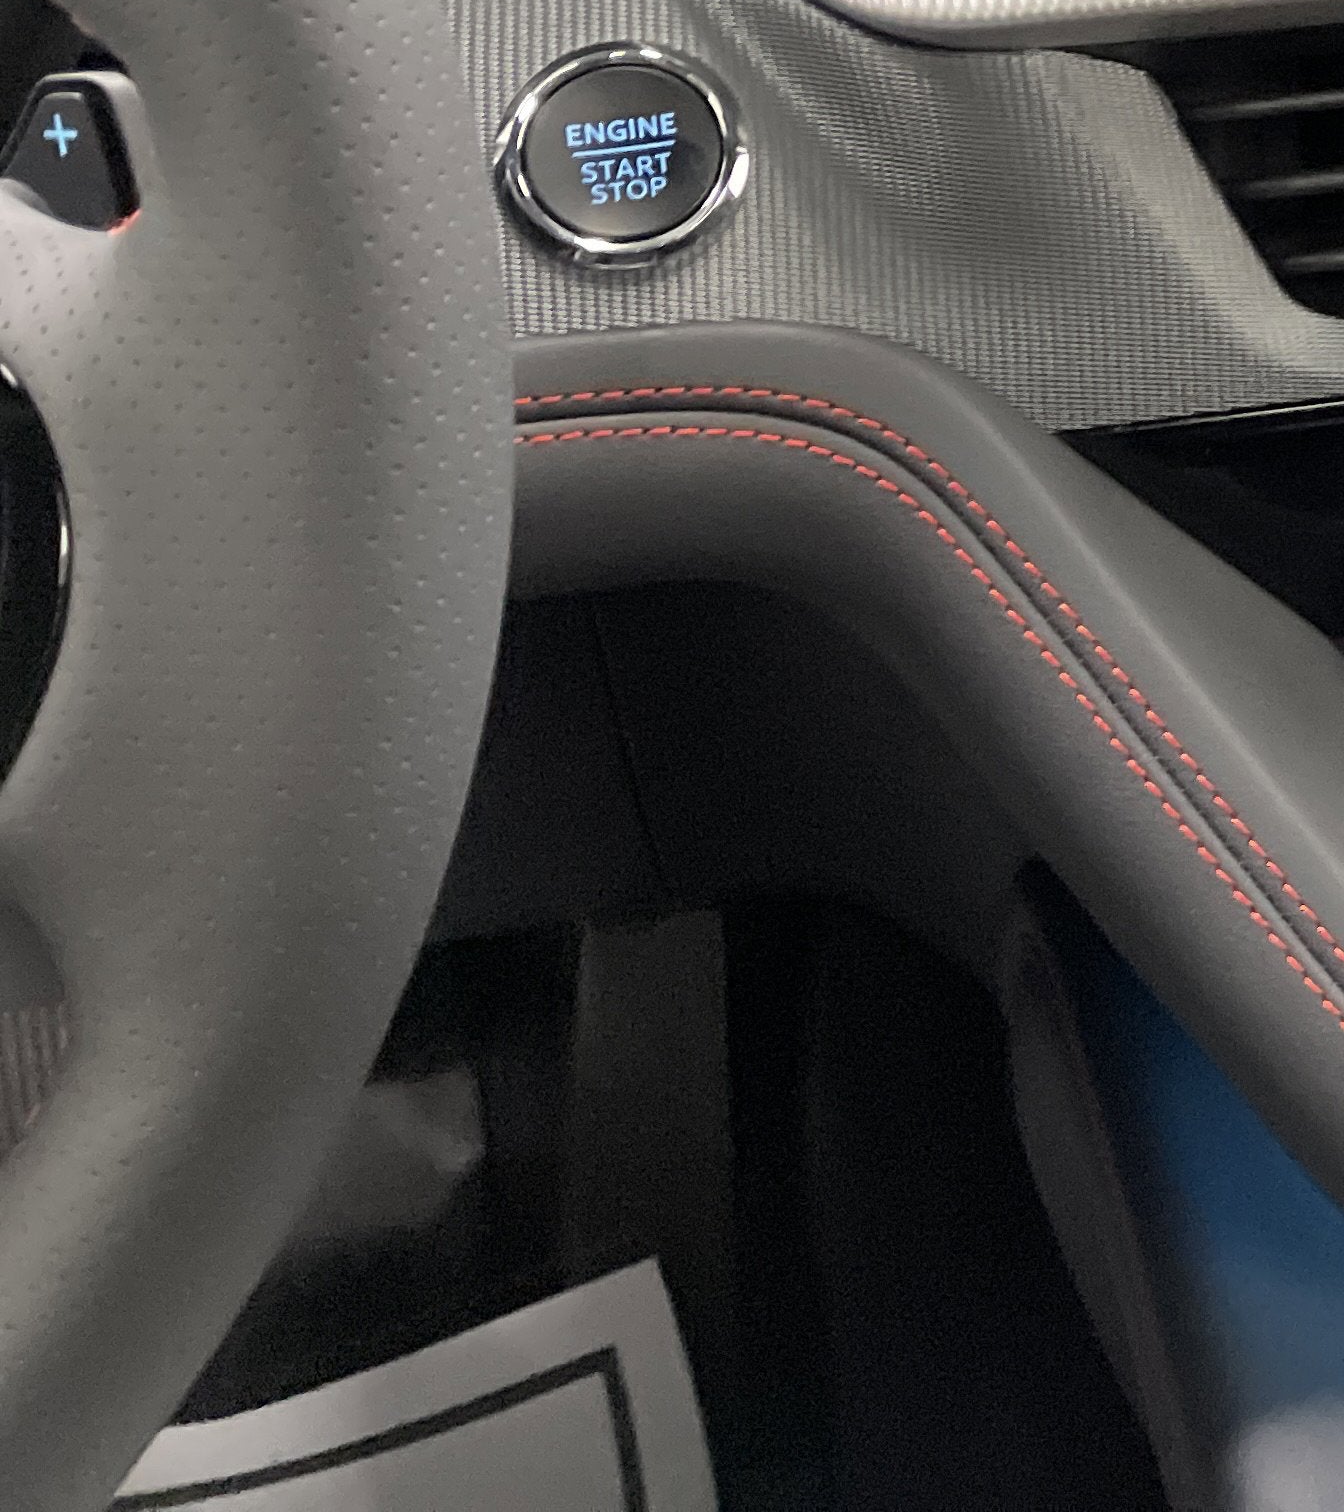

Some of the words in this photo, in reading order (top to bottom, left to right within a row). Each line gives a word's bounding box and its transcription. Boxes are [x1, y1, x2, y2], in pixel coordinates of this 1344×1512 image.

[564, 111, 678, 148] ENGINE
[580, 150, 672, 185] START
[589, 175, 668, 206] STOP
